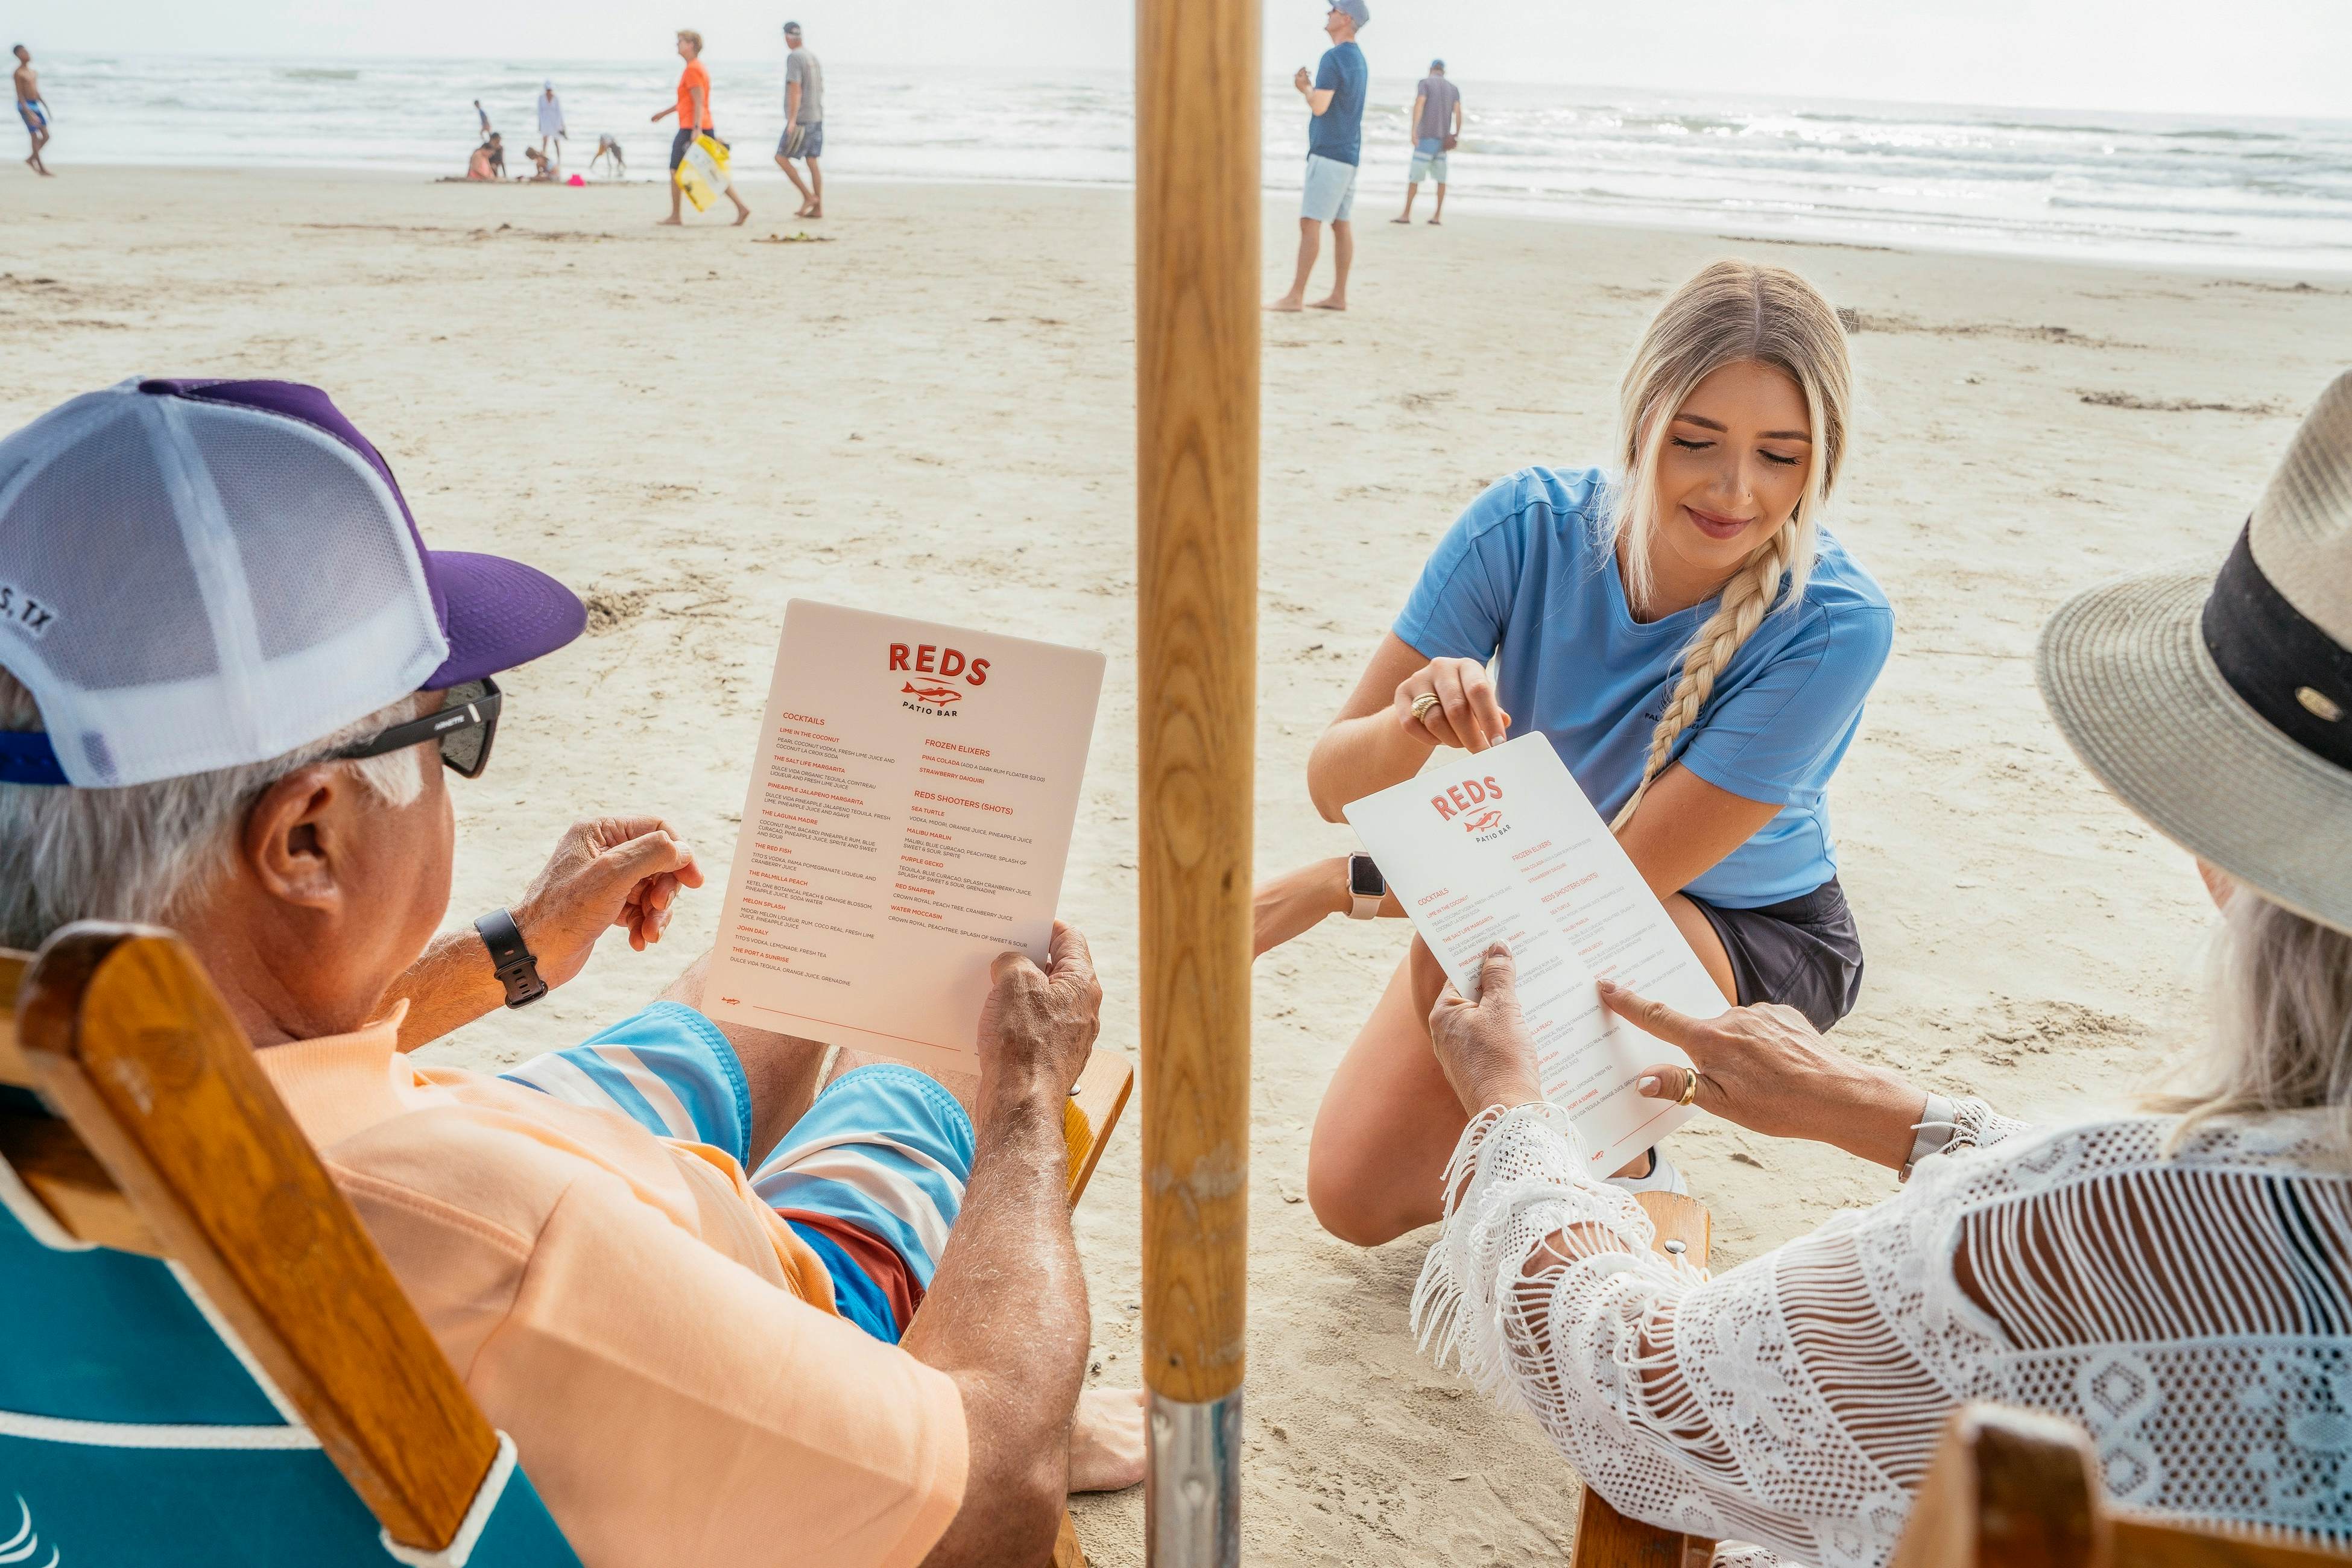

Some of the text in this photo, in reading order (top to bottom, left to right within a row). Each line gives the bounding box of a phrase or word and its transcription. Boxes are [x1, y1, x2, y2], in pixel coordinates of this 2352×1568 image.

[22, 600, 51, 631] TX
[890, 643, 991, 685] REDS
[903, 701, 932, 715] PATIO
[783, 712, 824, 725] COCKTAILS
[793, 740, 819, 748] COCONUT
[812, 733, 839, 742] COCONUT
[776, 743, 801, 751] COCONUT
[925, 739, 990, 757] FROZEN ELIXERS
[812, 762, 845, 773] MARGARITA
[936, 757, 959, 766] COLADA
[919, 767, 984, 784] STRAWBERRY DAIQUIRI
[847, 779, 876, 789] COINTREAU
[768, 782, 863, 805] PINEAPPLE JALAPENO MARGARITA
[1430, 776, 1502, 821] REDS
[914, 790, 1013, 815] REDS SHOOTERS (SHOTS)
[773, 812, 797, 820] LAGUNA
[797, 816, 818, 824] MADRE
[923, 808, 945, 817] TURTLE
[906, 827, 951, 841] MALIBU MARLIN
[949, 823, 971, 832] ORANGE
[988, 831, 1016, 841] PINEAPPLE
[1476, 824, 1511, 842] PATIO BAR
[1511, 849, 1533, 861] FROZEN
[1531, 840, 1552, 852] ELIXERS
[751, 858, 782, 868] CRANBERRY
[900, 855, 924, 864] PURPLE
[1529, 859, 1544, 868] COLADA
[760, 872, 787, 882] PALMILLA
[745, 885, 773, 895] PINEAPPLE
[907, 885, 935, 895] SNAPPER
[1541, 872, 1599, 903] REDS SHOOTERS (SHOTS)
[1418, 887, 1449, 905] COCKTAILS
[1449, 894, 1468, 907] COCONUT
[763, 902, 785, 910] SPLASH
[891, 905, 942, 919] WATER MOCCASIN
[966, 908, 997, 917] CRANBERRY
[1451, 931, 1461, 939] SALT
[1470, 915, 1494, 930] MARGARITA
[764, 953, 789, 963] SUNRISE
[1458, 953, 1482, 967] PINEAPPLE
[782, 967, 804, 976] ORANGE
[821, 976, 850, 986] GRENADINE
[1539, 1019, 1554, 1030] PEACH
[1543, 1051, 1559, 1062] SPLASH
[1594, 1068, 1607, 1078] FRESH
[1546, 1080, 1567, 1095] JOHN DALY
[1567, 1101, 1578, 1110] PORT
[1581, 1089, 1598, 1101] SUNRISE
[1599, 1090, 1614, 1102] ORANGE
